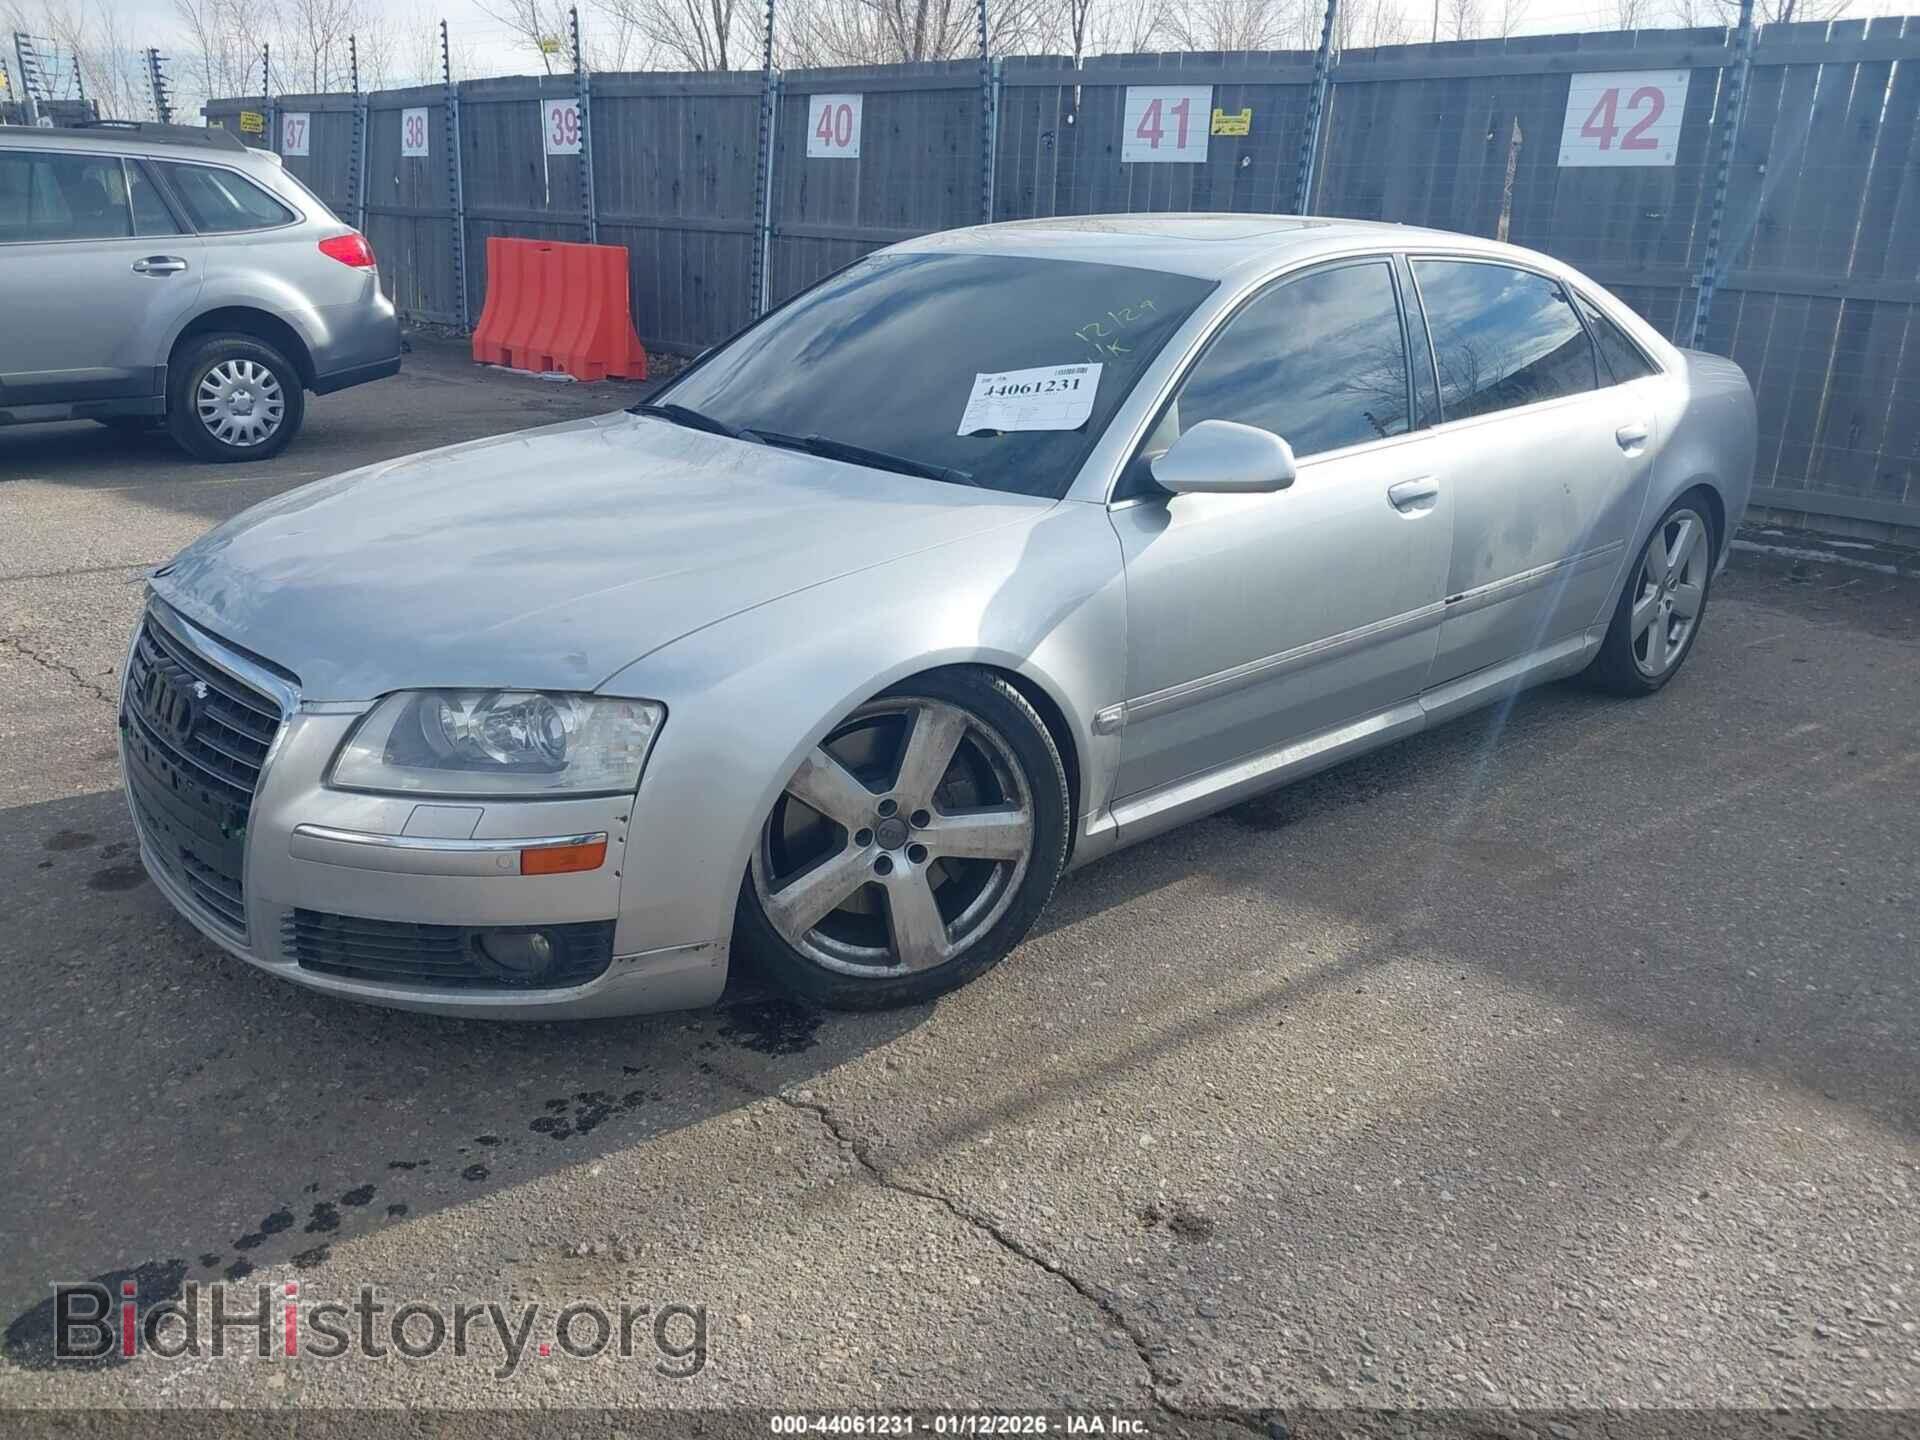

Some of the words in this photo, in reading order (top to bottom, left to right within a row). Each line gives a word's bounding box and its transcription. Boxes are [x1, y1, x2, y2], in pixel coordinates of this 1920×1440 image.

[287, 119, 305, 149] 37
[406, 115, 424, 148] 38
[551, 107, 578, 146] 39
[815, 103, 853, 148] 40
[1136, 97, 1190, 149] 41
[1580, 86, 1665, 150] 42
[983, 378, 1081, 397] 44061231
